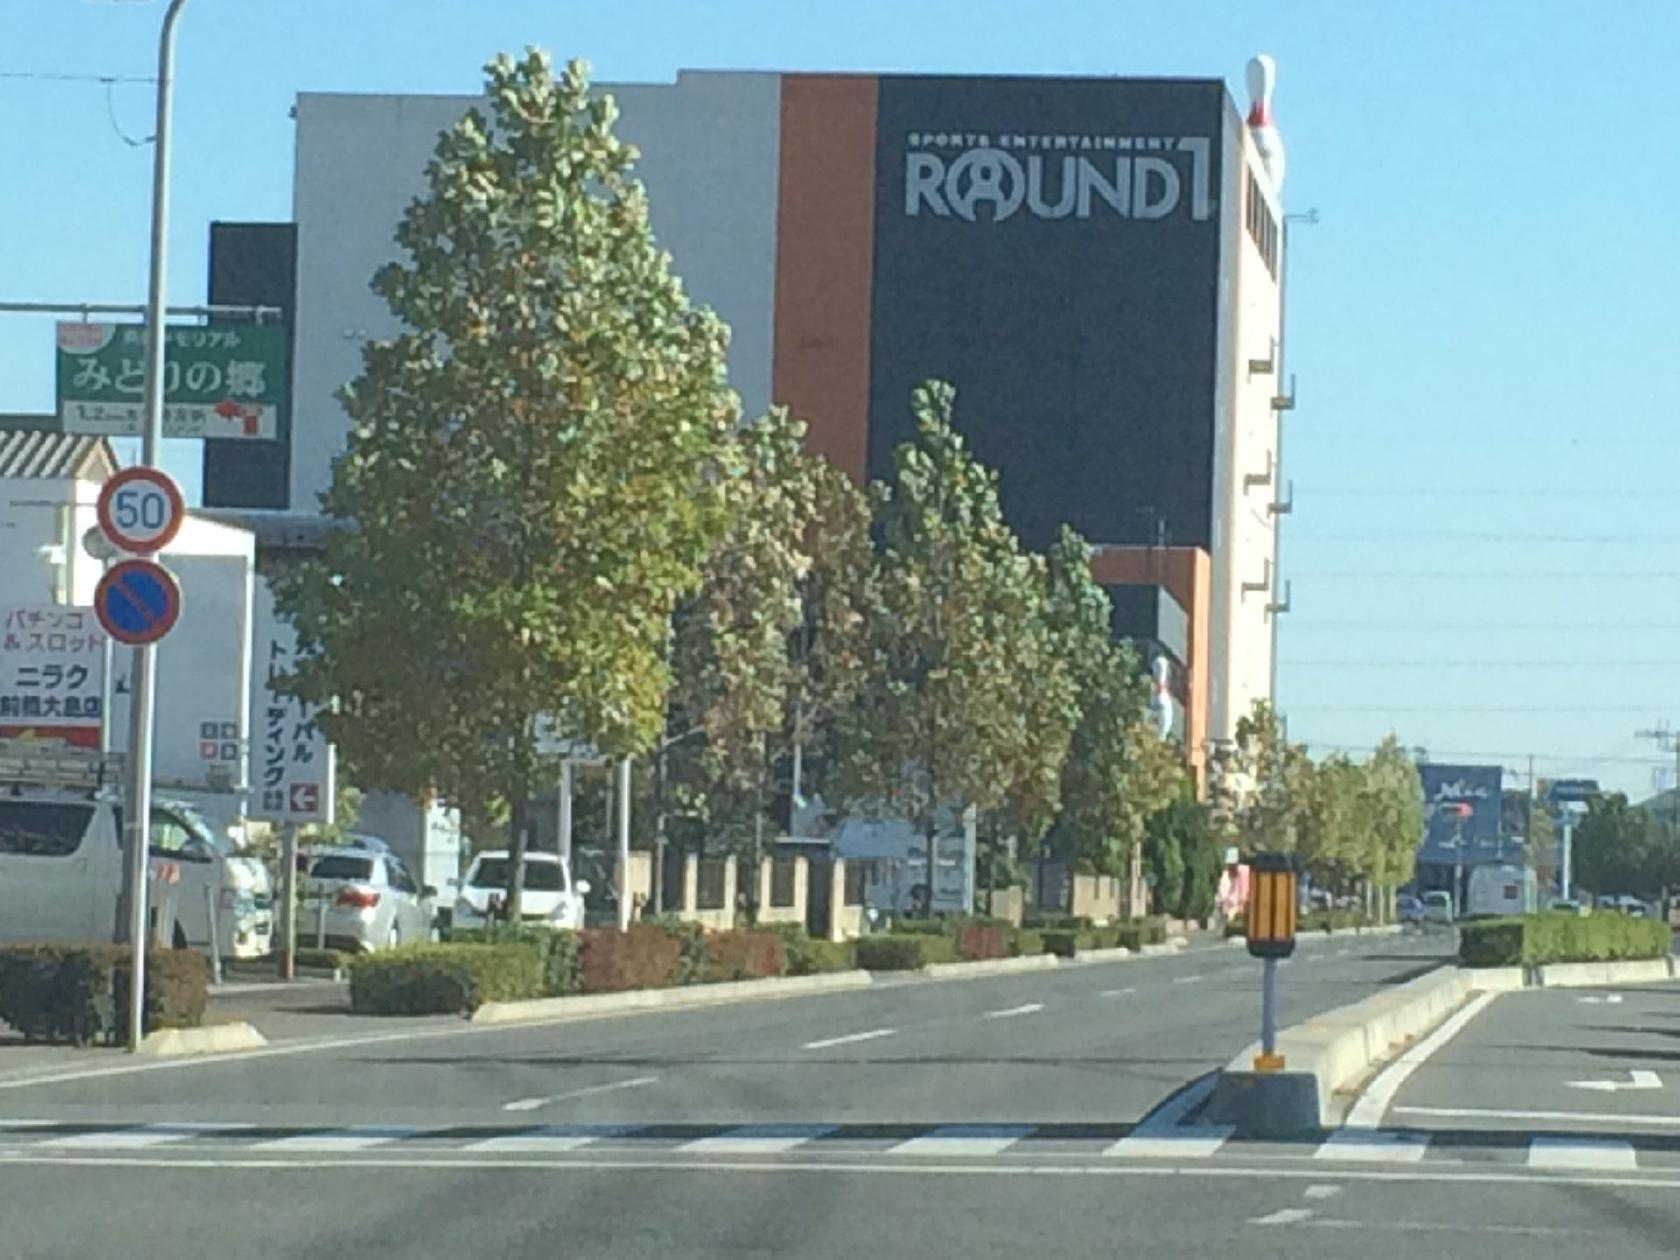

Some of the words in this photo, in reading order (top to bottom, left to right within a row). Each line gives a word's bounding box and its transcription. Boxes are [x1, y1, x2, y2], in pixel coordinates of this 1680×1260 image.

[908, 132, 989, 147] SPORTS
[1000, 134, 1178, 150] ENTERTAINMENT
[116, 491, 165, 530] 50
[5, 608, 83, 630] パチンコ
[16, 663, 89, 690] ニラク
